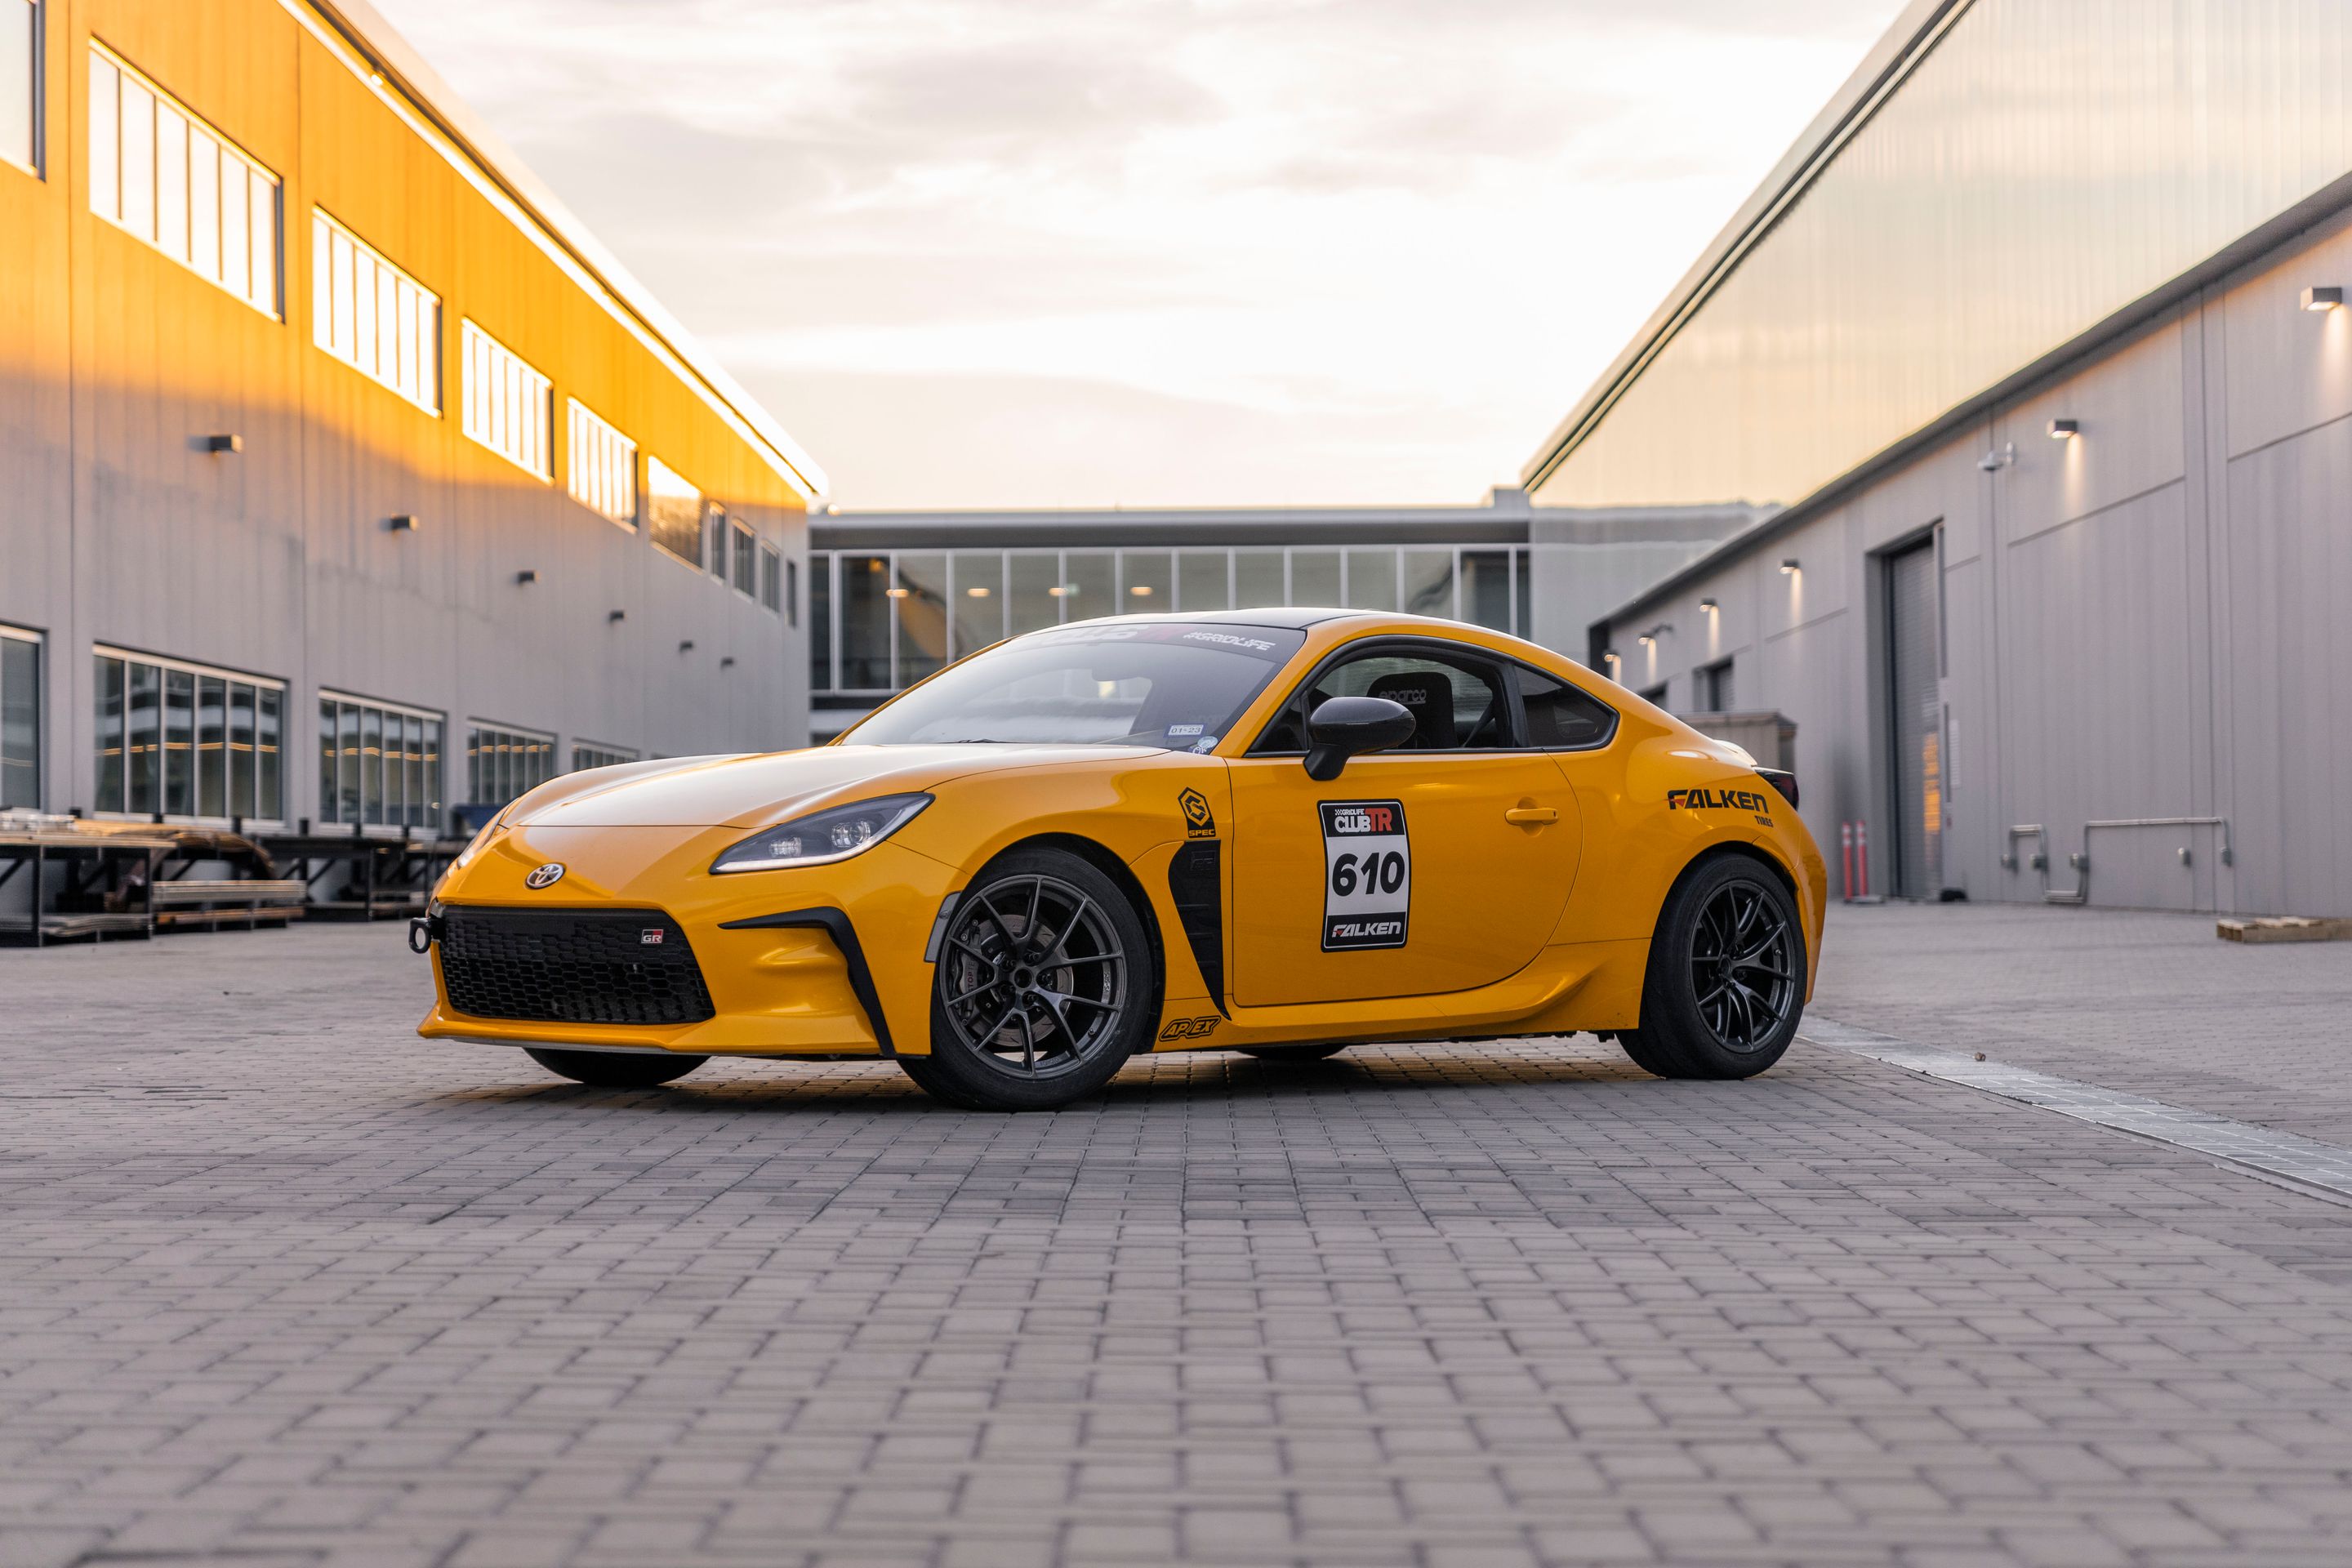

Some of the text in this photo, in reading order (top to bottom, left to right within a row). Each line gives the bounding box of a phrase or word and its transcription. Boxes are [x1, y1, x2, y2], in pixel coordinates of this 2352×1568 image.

[1667, 789, 1770, 814] FALKEN
[1754, 815, 1774, 827] TIRES
[1332, 851, 1405, 897] 610
[643, 934, 662, 942] GR
[1331, 921, 1401, 938] FALKEN
[1161, 1018, 1218, 1039] APEX
